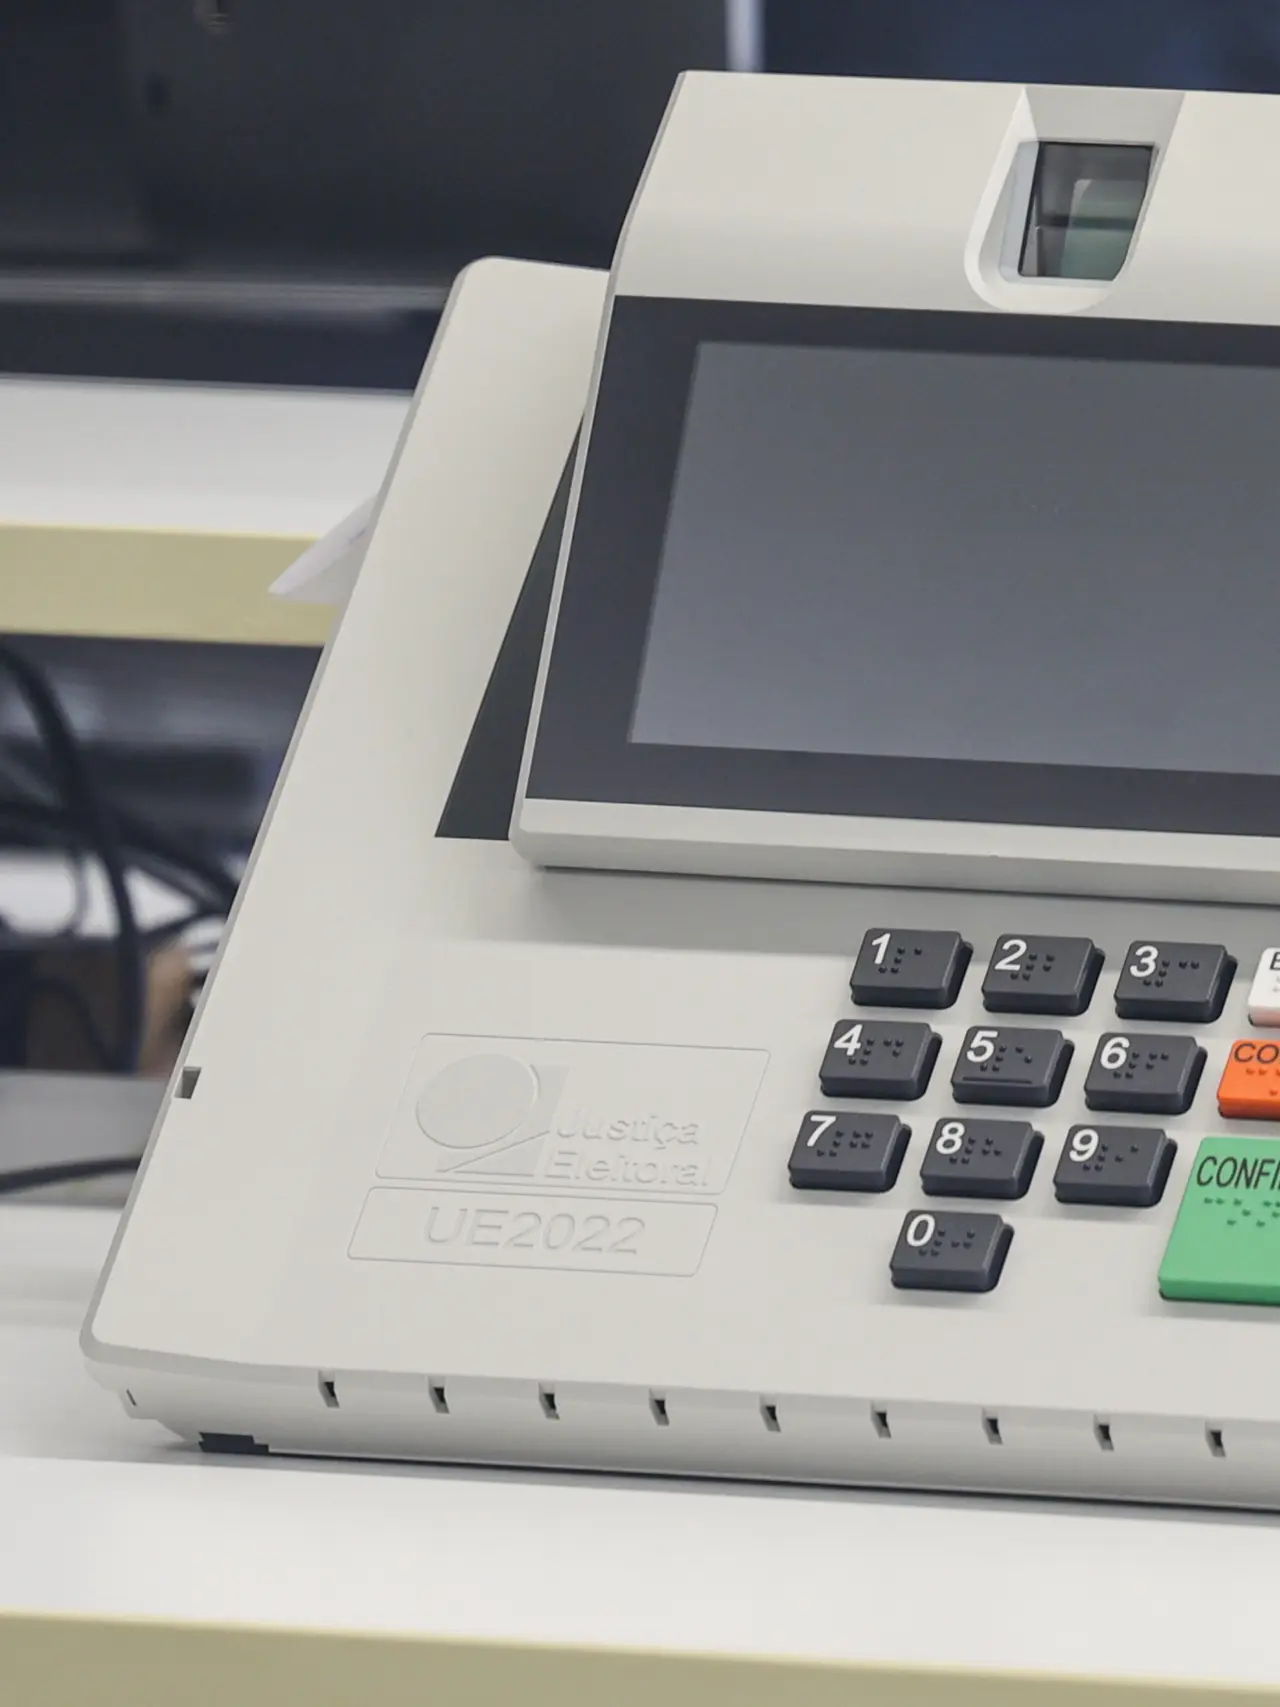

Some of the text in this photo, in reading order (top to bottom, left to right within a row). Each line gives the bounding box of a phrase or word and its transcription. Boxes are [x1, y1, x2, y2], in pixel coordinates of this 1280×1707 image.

[871, 933, 891, 965] 1
[994, 939, 1027, 971] 2
[1129, 945, 1159, 978] 3
[833, 1024, 862, 1056] 4
[966, 1030, 999, 1063] 5
[1100, 1036, 1130, 1070] 6
[556, 1108, 700, 1150] Justiça
[806, 1114, 837, 1147] 7
[935, 1121, 965, 1155] 8
[1069, 1128, 1099, 1162] 9
[543, 1150, 711, 1187] Eleitoral
[423, 1206, 646, 1255] UE2022
